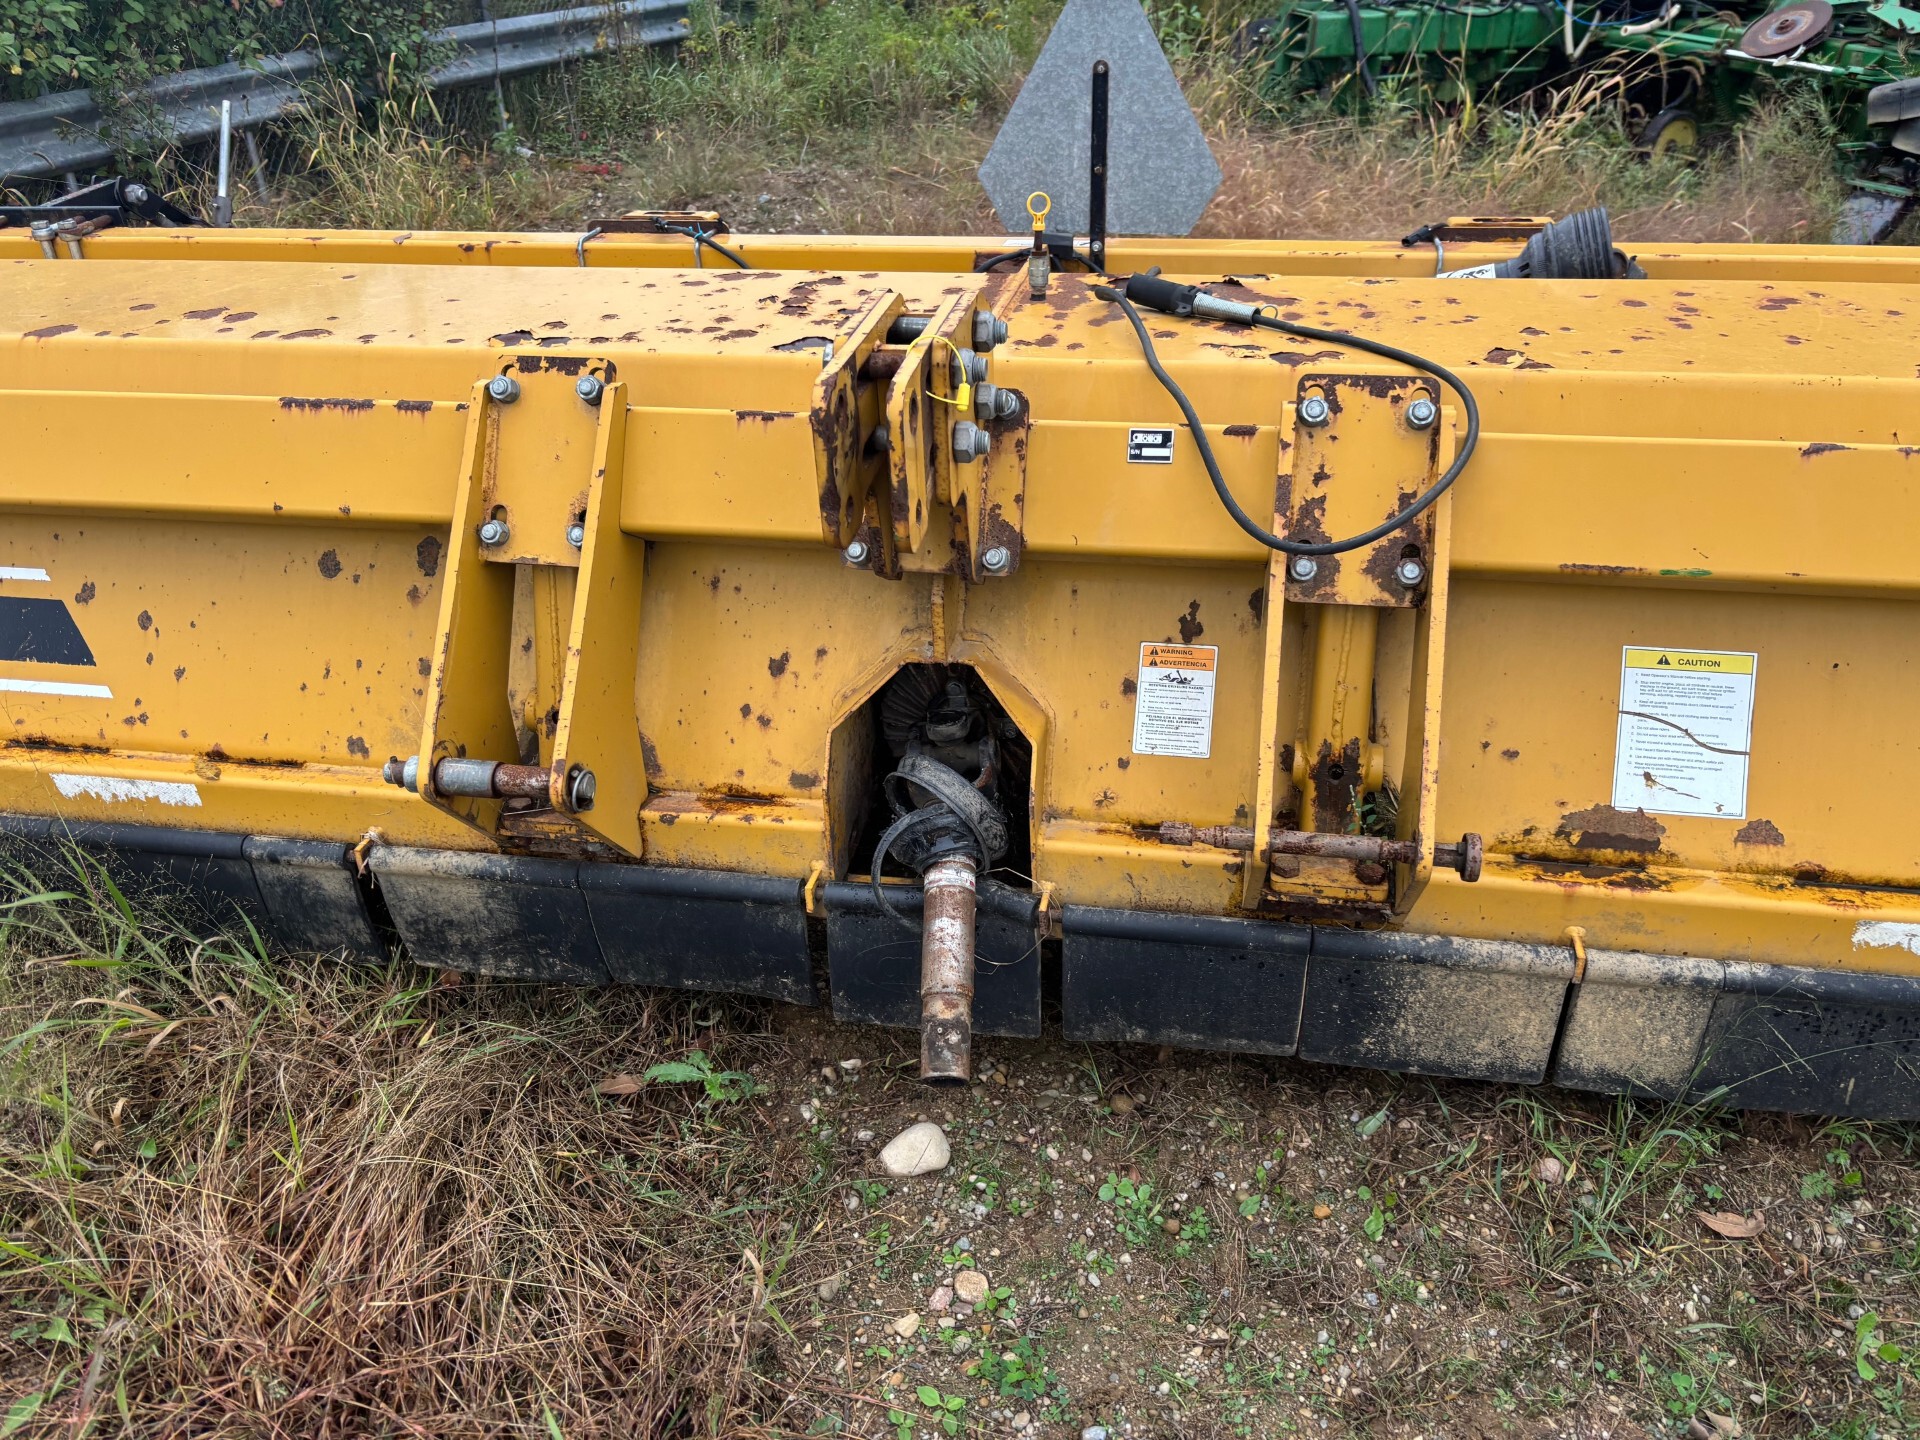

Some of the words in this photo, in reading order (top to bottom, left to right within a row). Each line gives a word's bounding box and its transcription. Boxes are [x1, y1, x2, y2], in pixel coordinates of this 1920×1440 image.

[1160, 648, 1193, 656] WARNING
[1159, 659, 1207, 668] ADVERTENCIA
[1678, 658, 1721, 668] CAUTION
